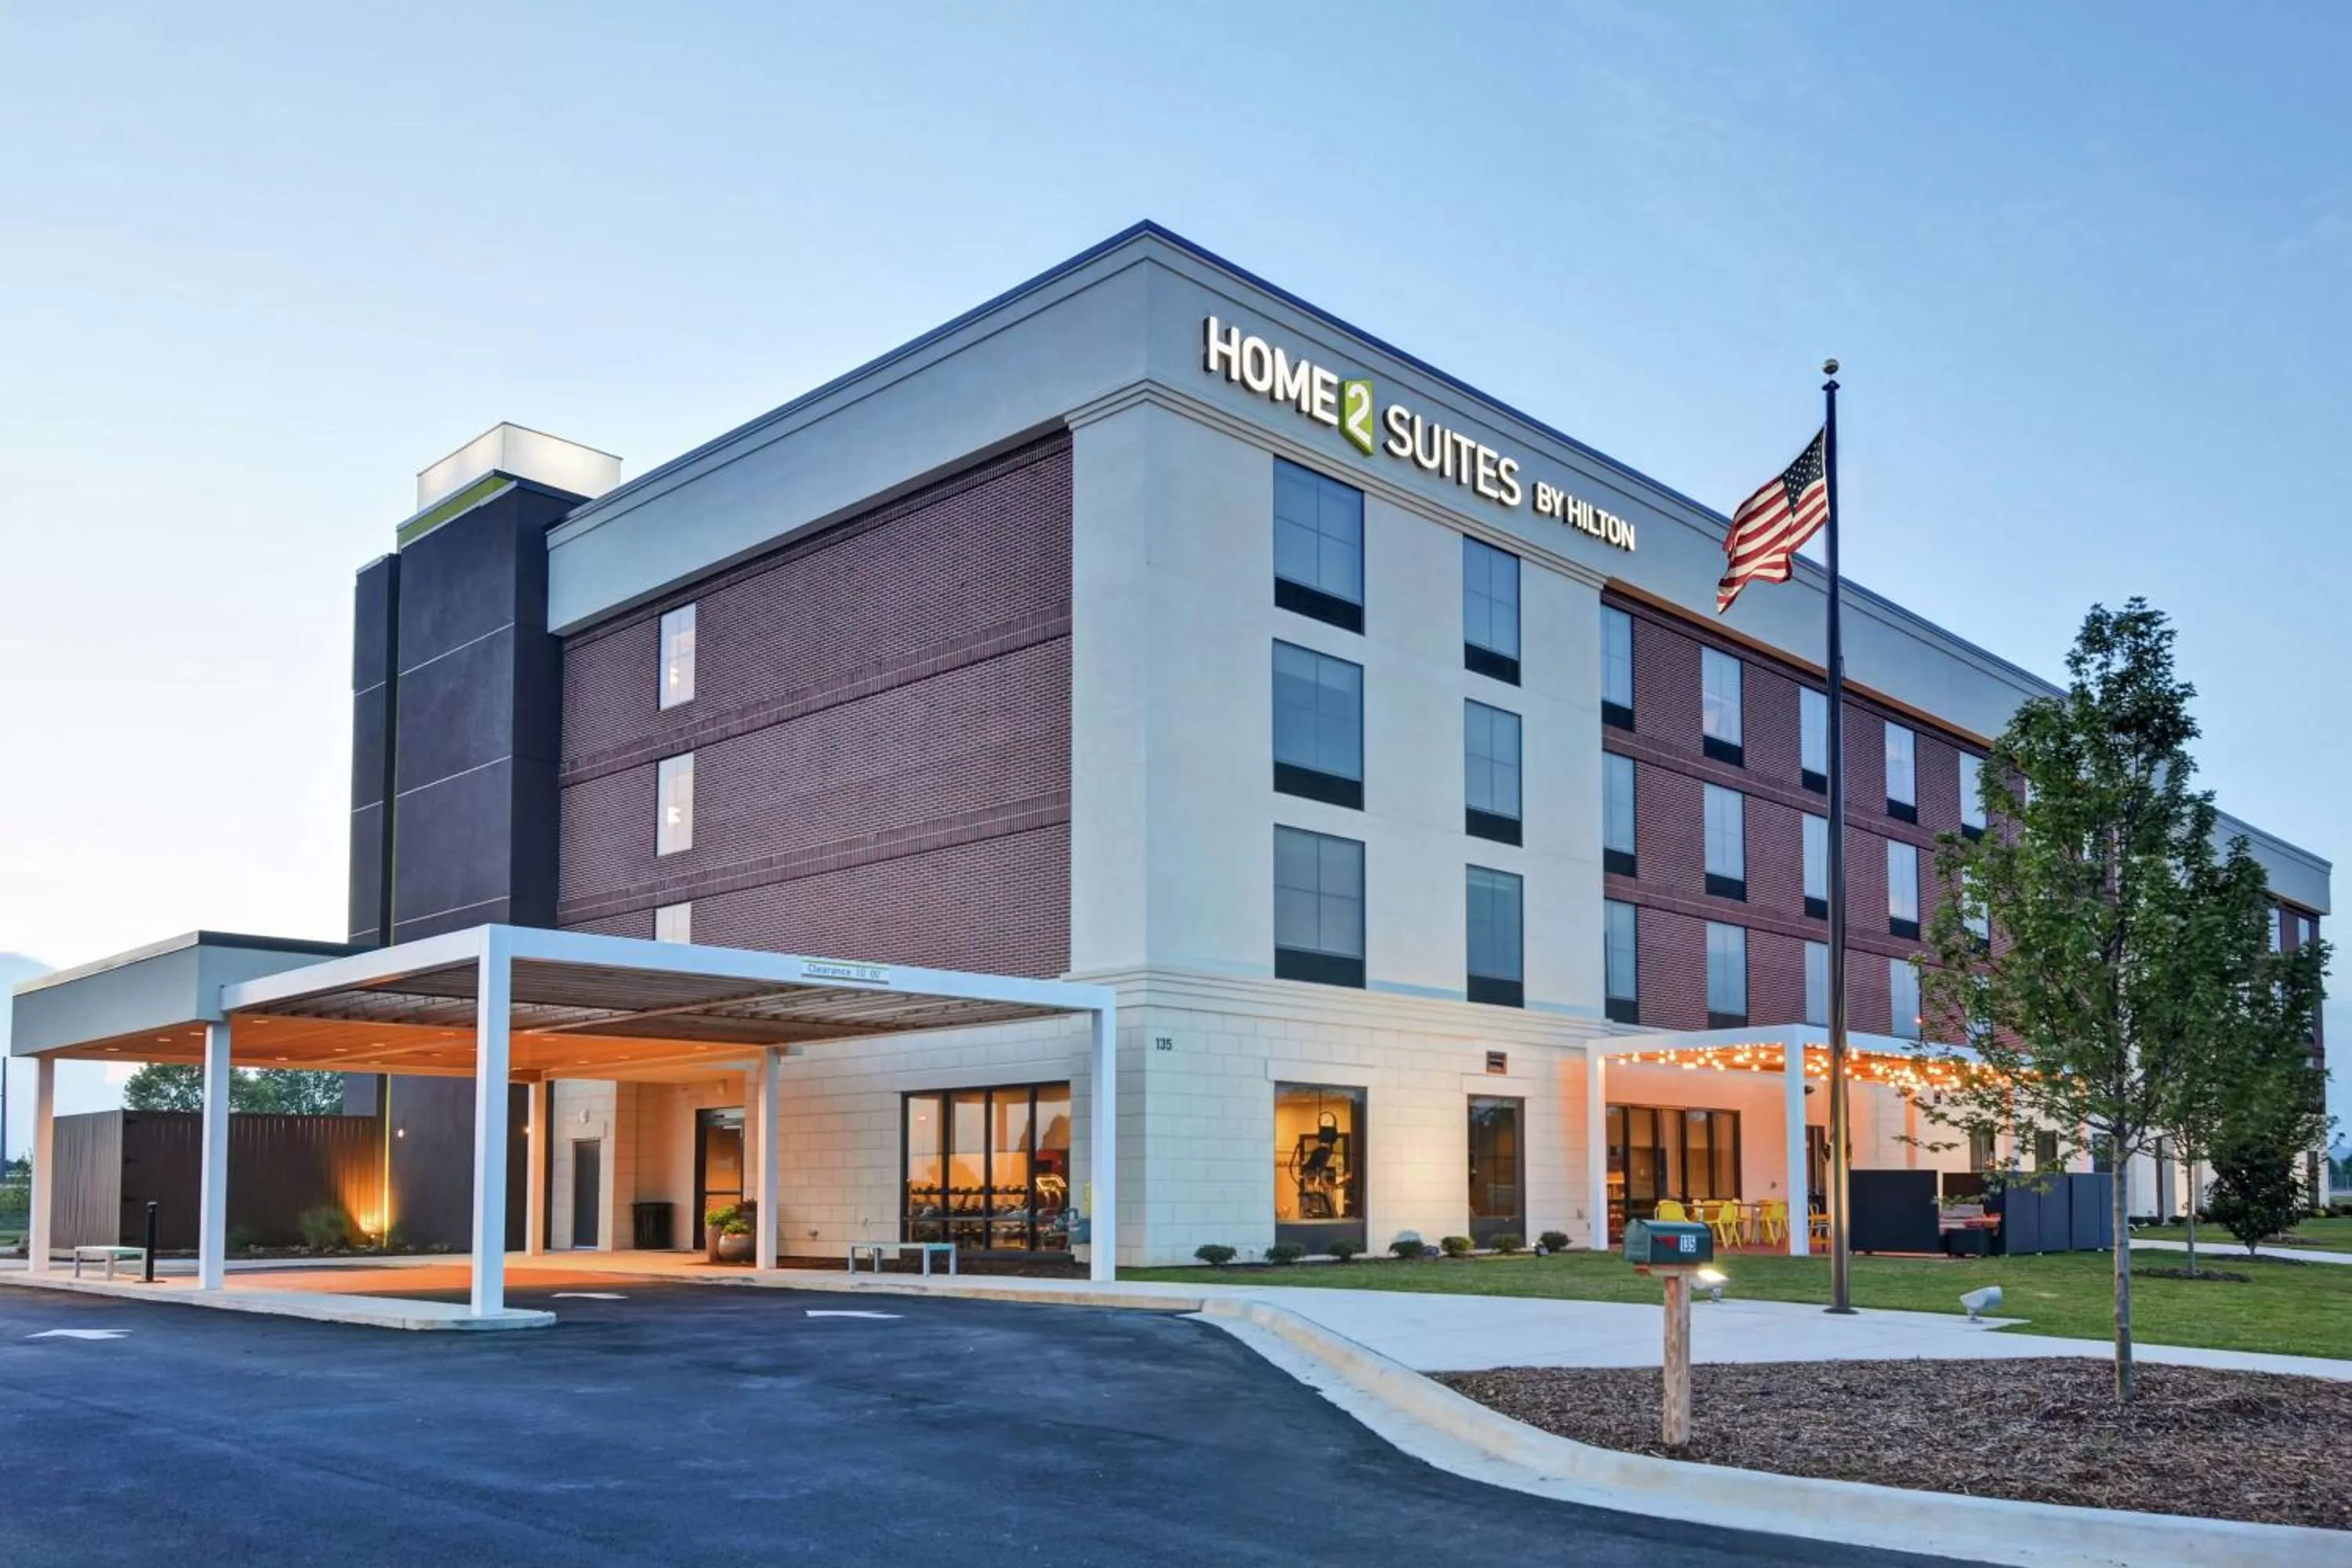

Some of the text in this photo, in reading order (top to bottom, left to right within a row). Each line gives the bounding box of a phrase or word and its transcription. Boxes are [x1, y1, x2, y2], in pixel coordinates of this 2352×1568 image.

[1385, 405, 1522, 506] SUITES
[1534, 481, 1565, 517] BY
[1566, 497, 1636, 551] HILTON
[808, 964, 851, 976] Clearance
[1155, 1037, 1173, 1051] 135
